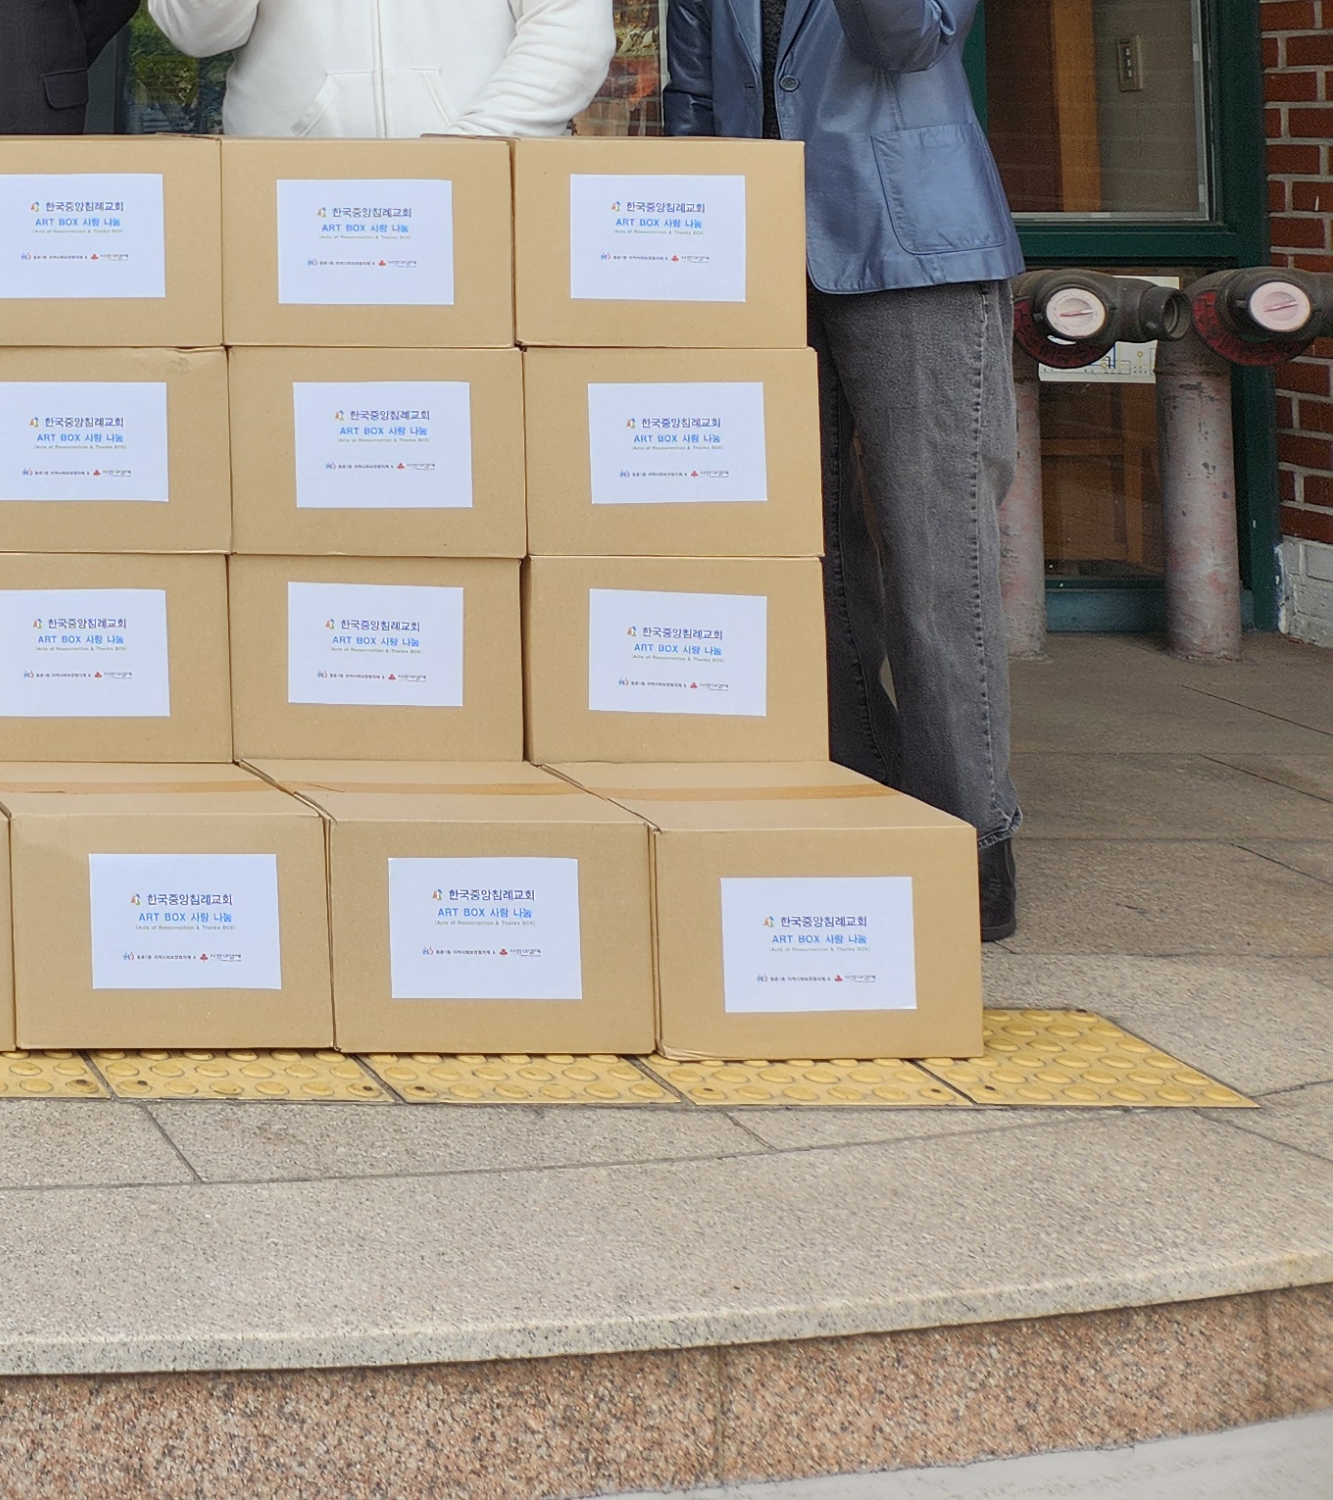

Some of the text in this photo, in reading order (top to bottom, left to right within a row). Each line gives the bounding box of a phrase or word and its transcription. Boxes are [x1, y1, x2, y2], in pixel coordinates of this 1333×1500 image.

[627, 200, 705, 214] 한국중앙침례교회
[616, 217, 702, 229] ART BOX 사랑 나눔
[449, 888, 534, 902] 한국중앙침례교회
[438, 907, 532, 919] ART BOX 사랑 나눔
